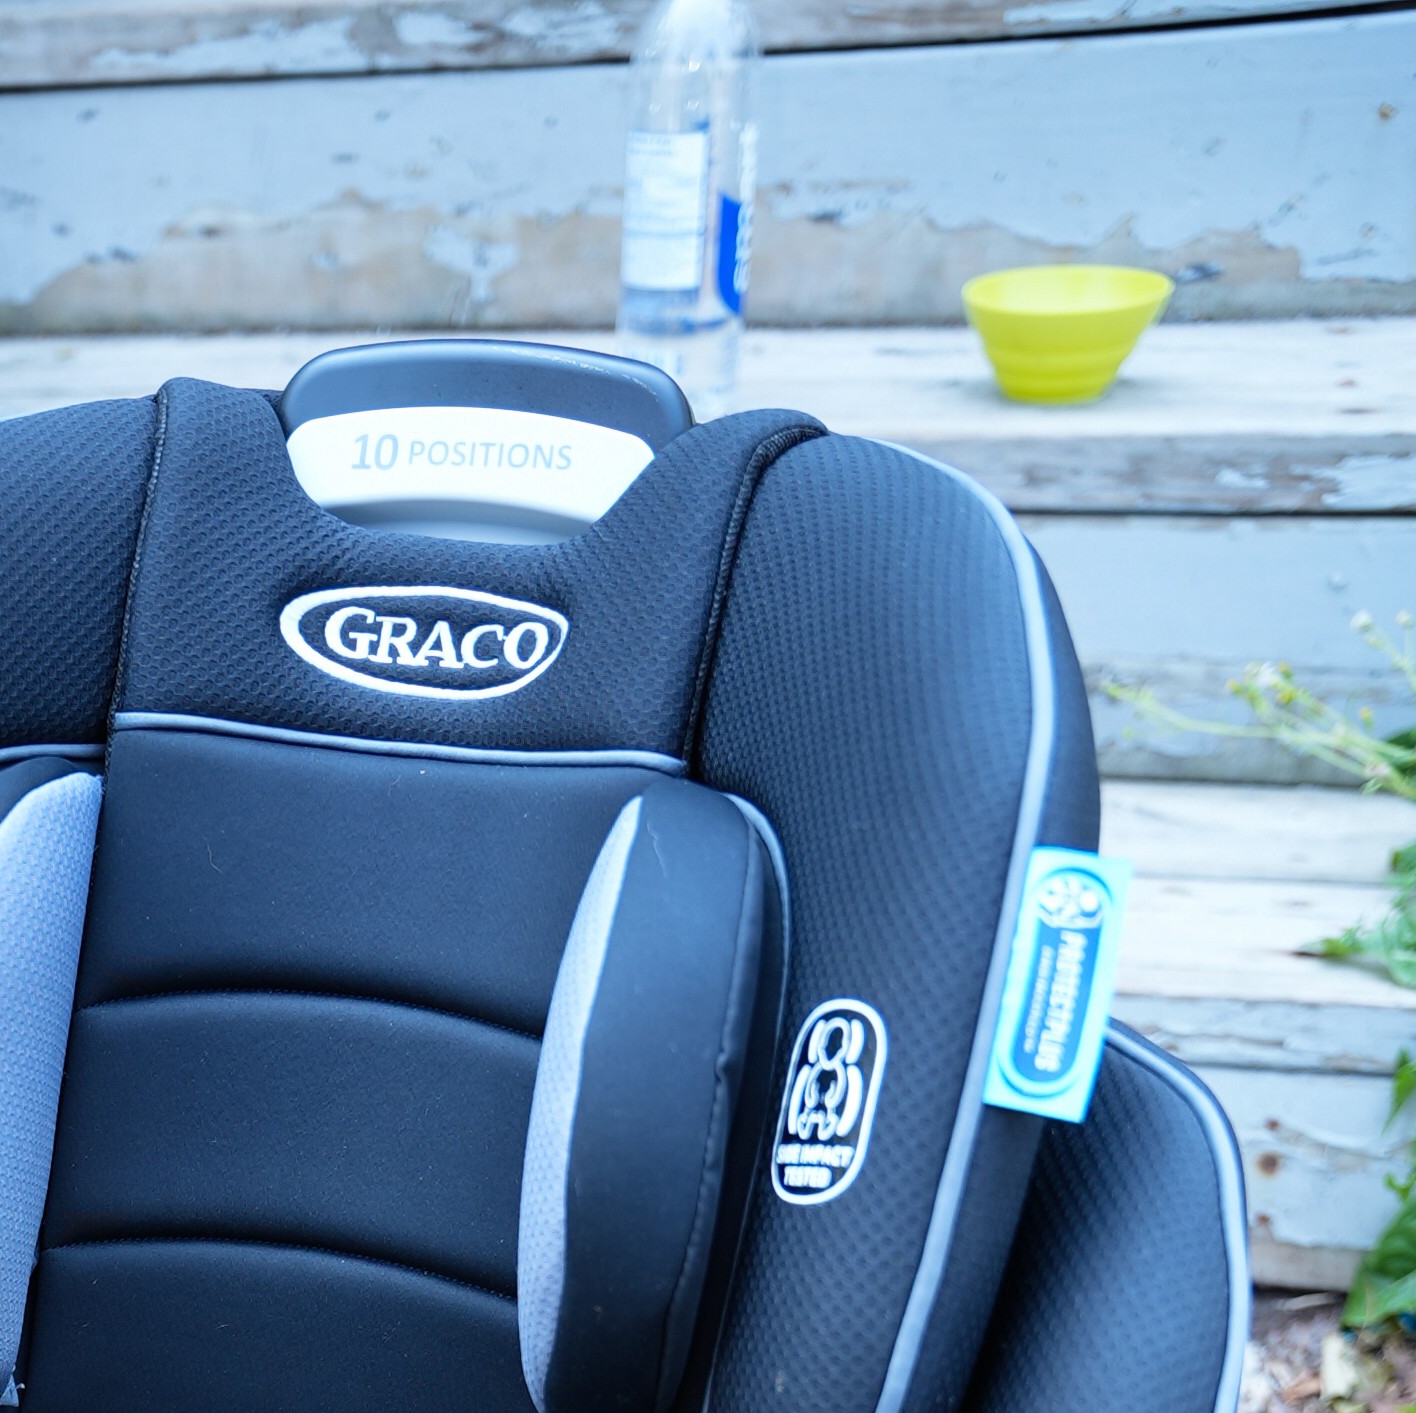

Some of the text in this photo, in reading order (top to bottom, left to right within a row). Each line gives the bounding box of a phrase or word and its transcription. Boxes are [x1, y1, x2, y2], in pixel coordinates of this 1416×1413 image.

[351, 433, 573, 472] 10 POSITIONS
[324, 604, 549, 670] GRACO
[800, 1143, 855, 1169] IMPACT
